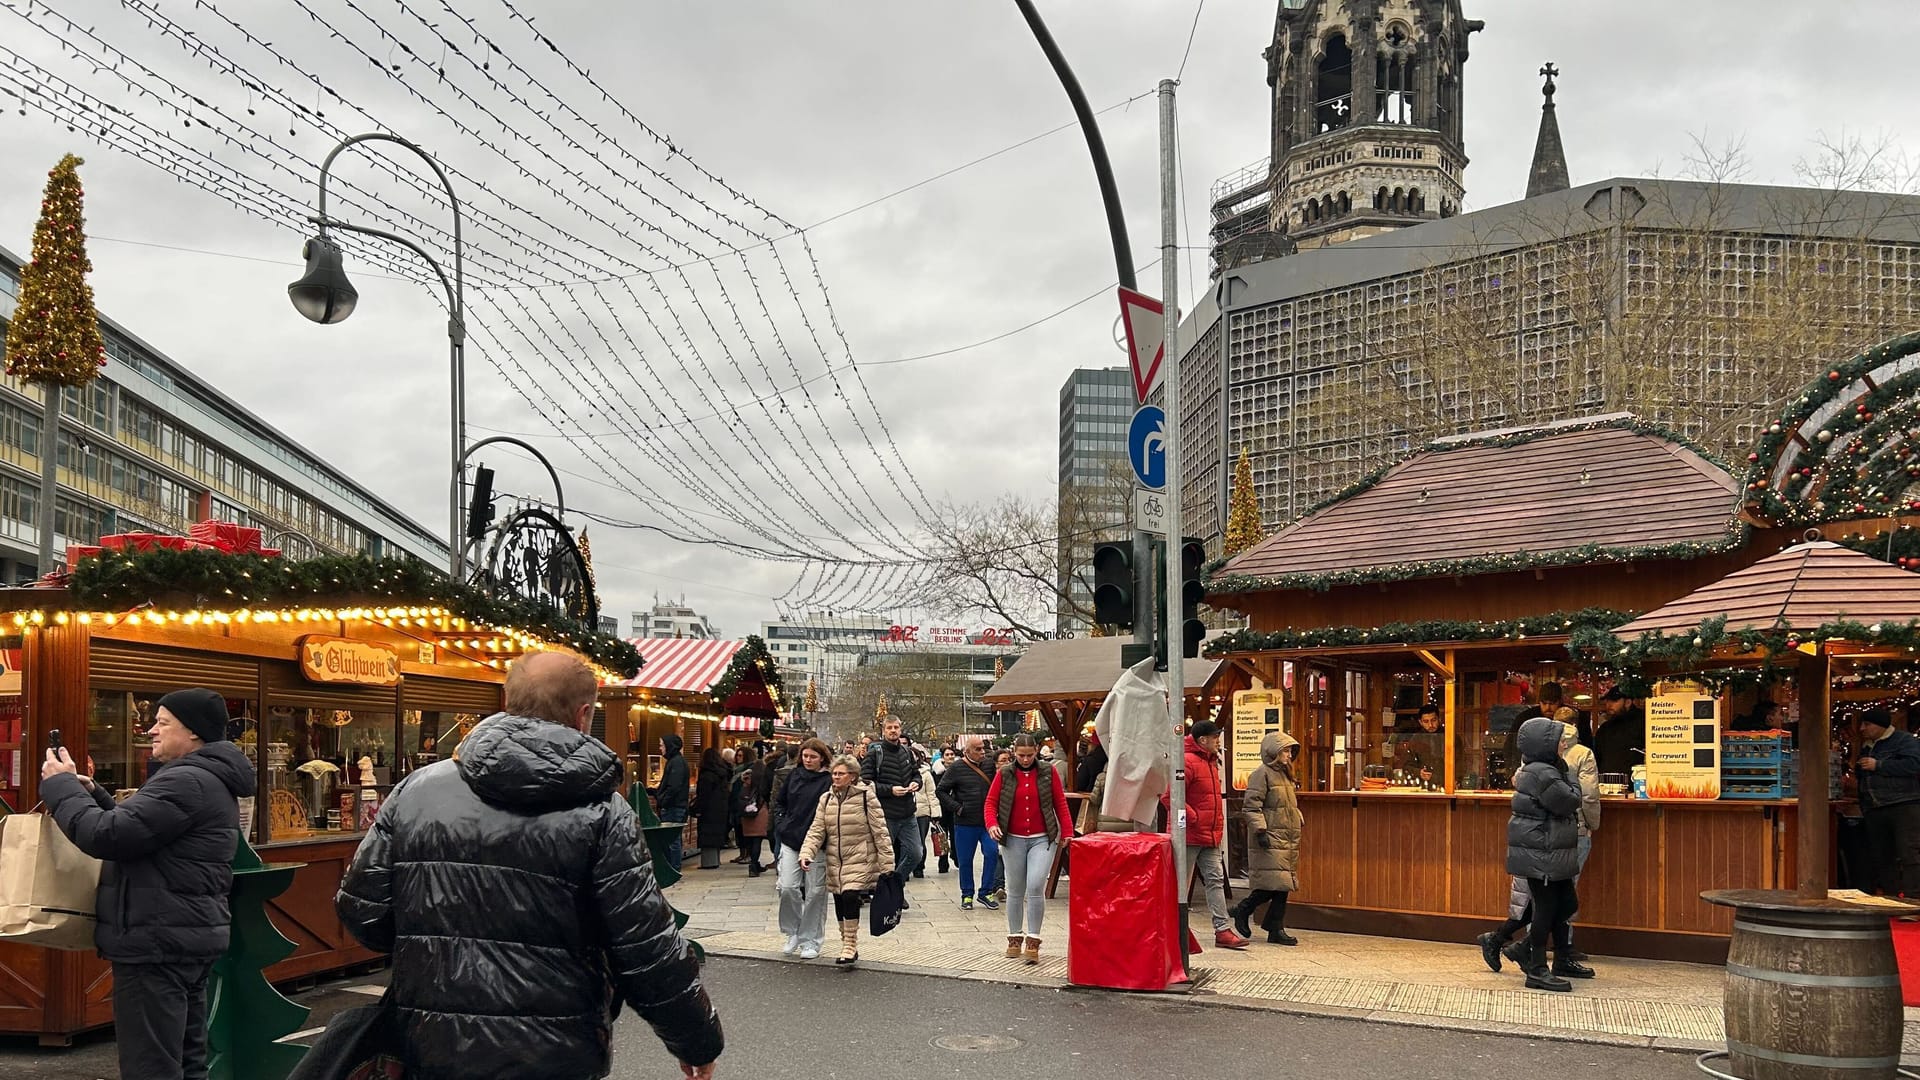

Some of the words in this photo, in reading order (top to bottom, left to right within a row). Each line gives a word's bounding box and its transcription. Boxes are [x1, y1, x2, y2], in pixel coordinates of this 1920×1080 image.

[1148, 518, 1160, 528] frei
[930, 627, 940, 635] DIE
[942, 627, 968, 636] STIMME
[934, 635, 963, 644] BERLINS
[326, 647, 386, 679] Glühwein
